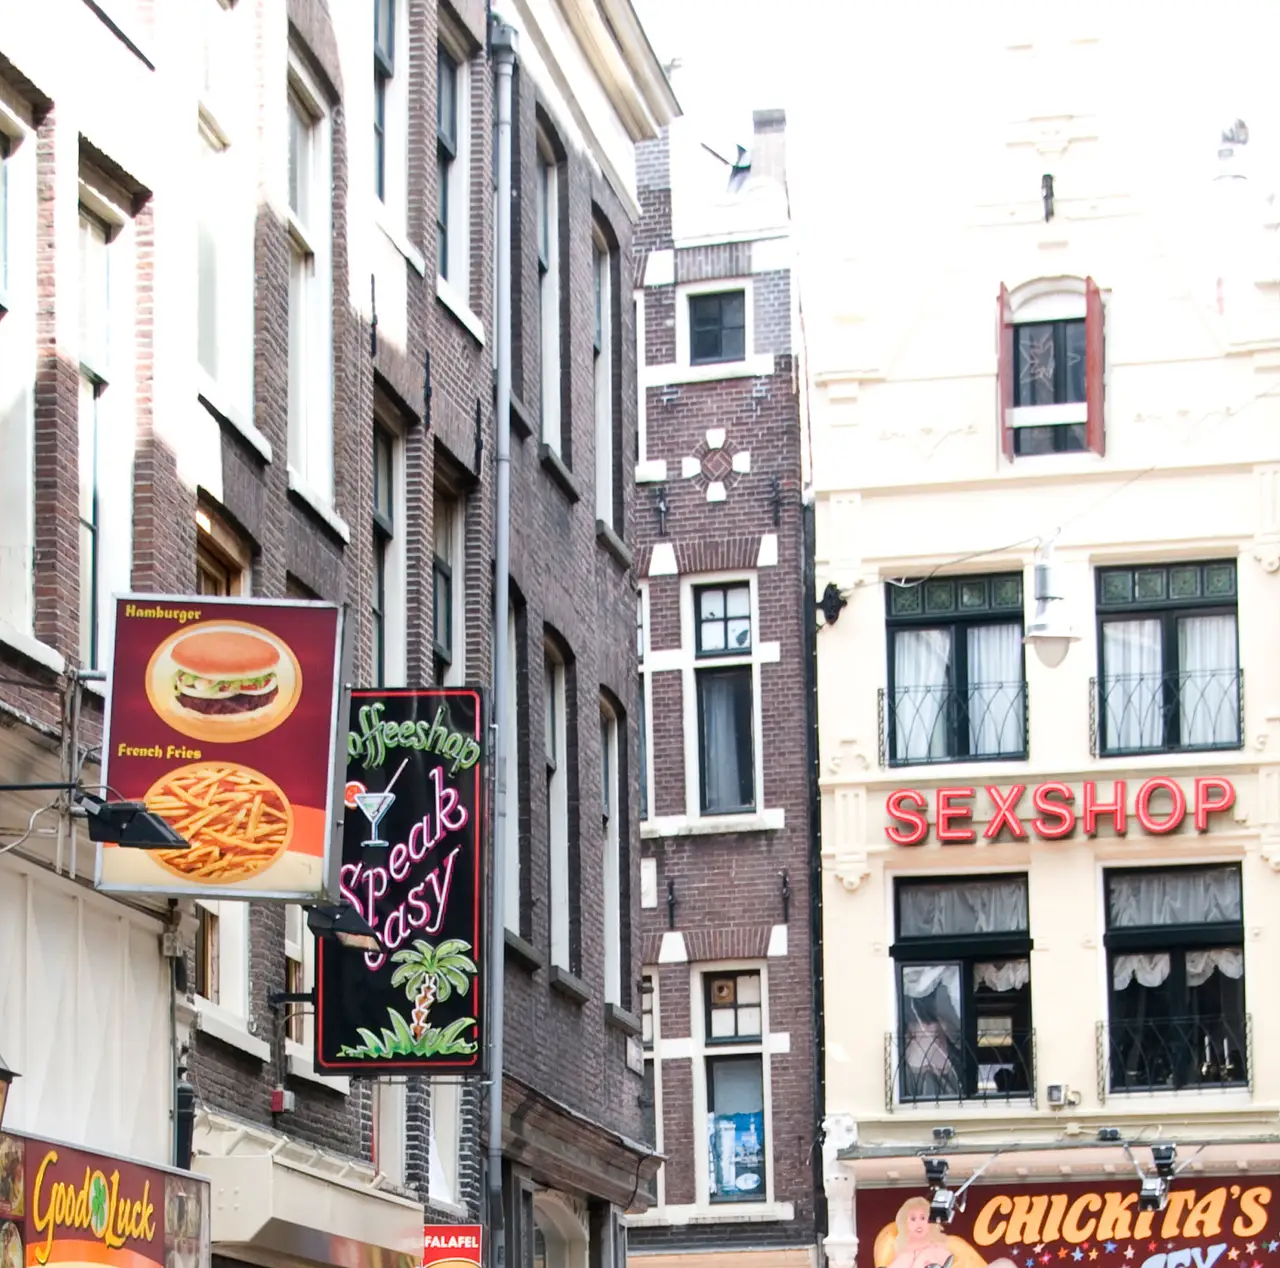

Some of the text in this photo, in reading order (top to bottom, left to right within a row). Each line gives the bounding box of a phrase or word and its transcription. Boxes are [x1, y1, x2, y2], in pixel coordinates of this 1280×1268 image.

[125, 604, 202, 624] Hamburger
[117, 744, 202, 760] French Fries
[346, 702, 481, 777] offeeshop
[884, 775, 1238, 847] SEXSHOP
[33, 1150, 157, 1265] Good Luck
[425, 1235, 479, 1248] FALAFEL
